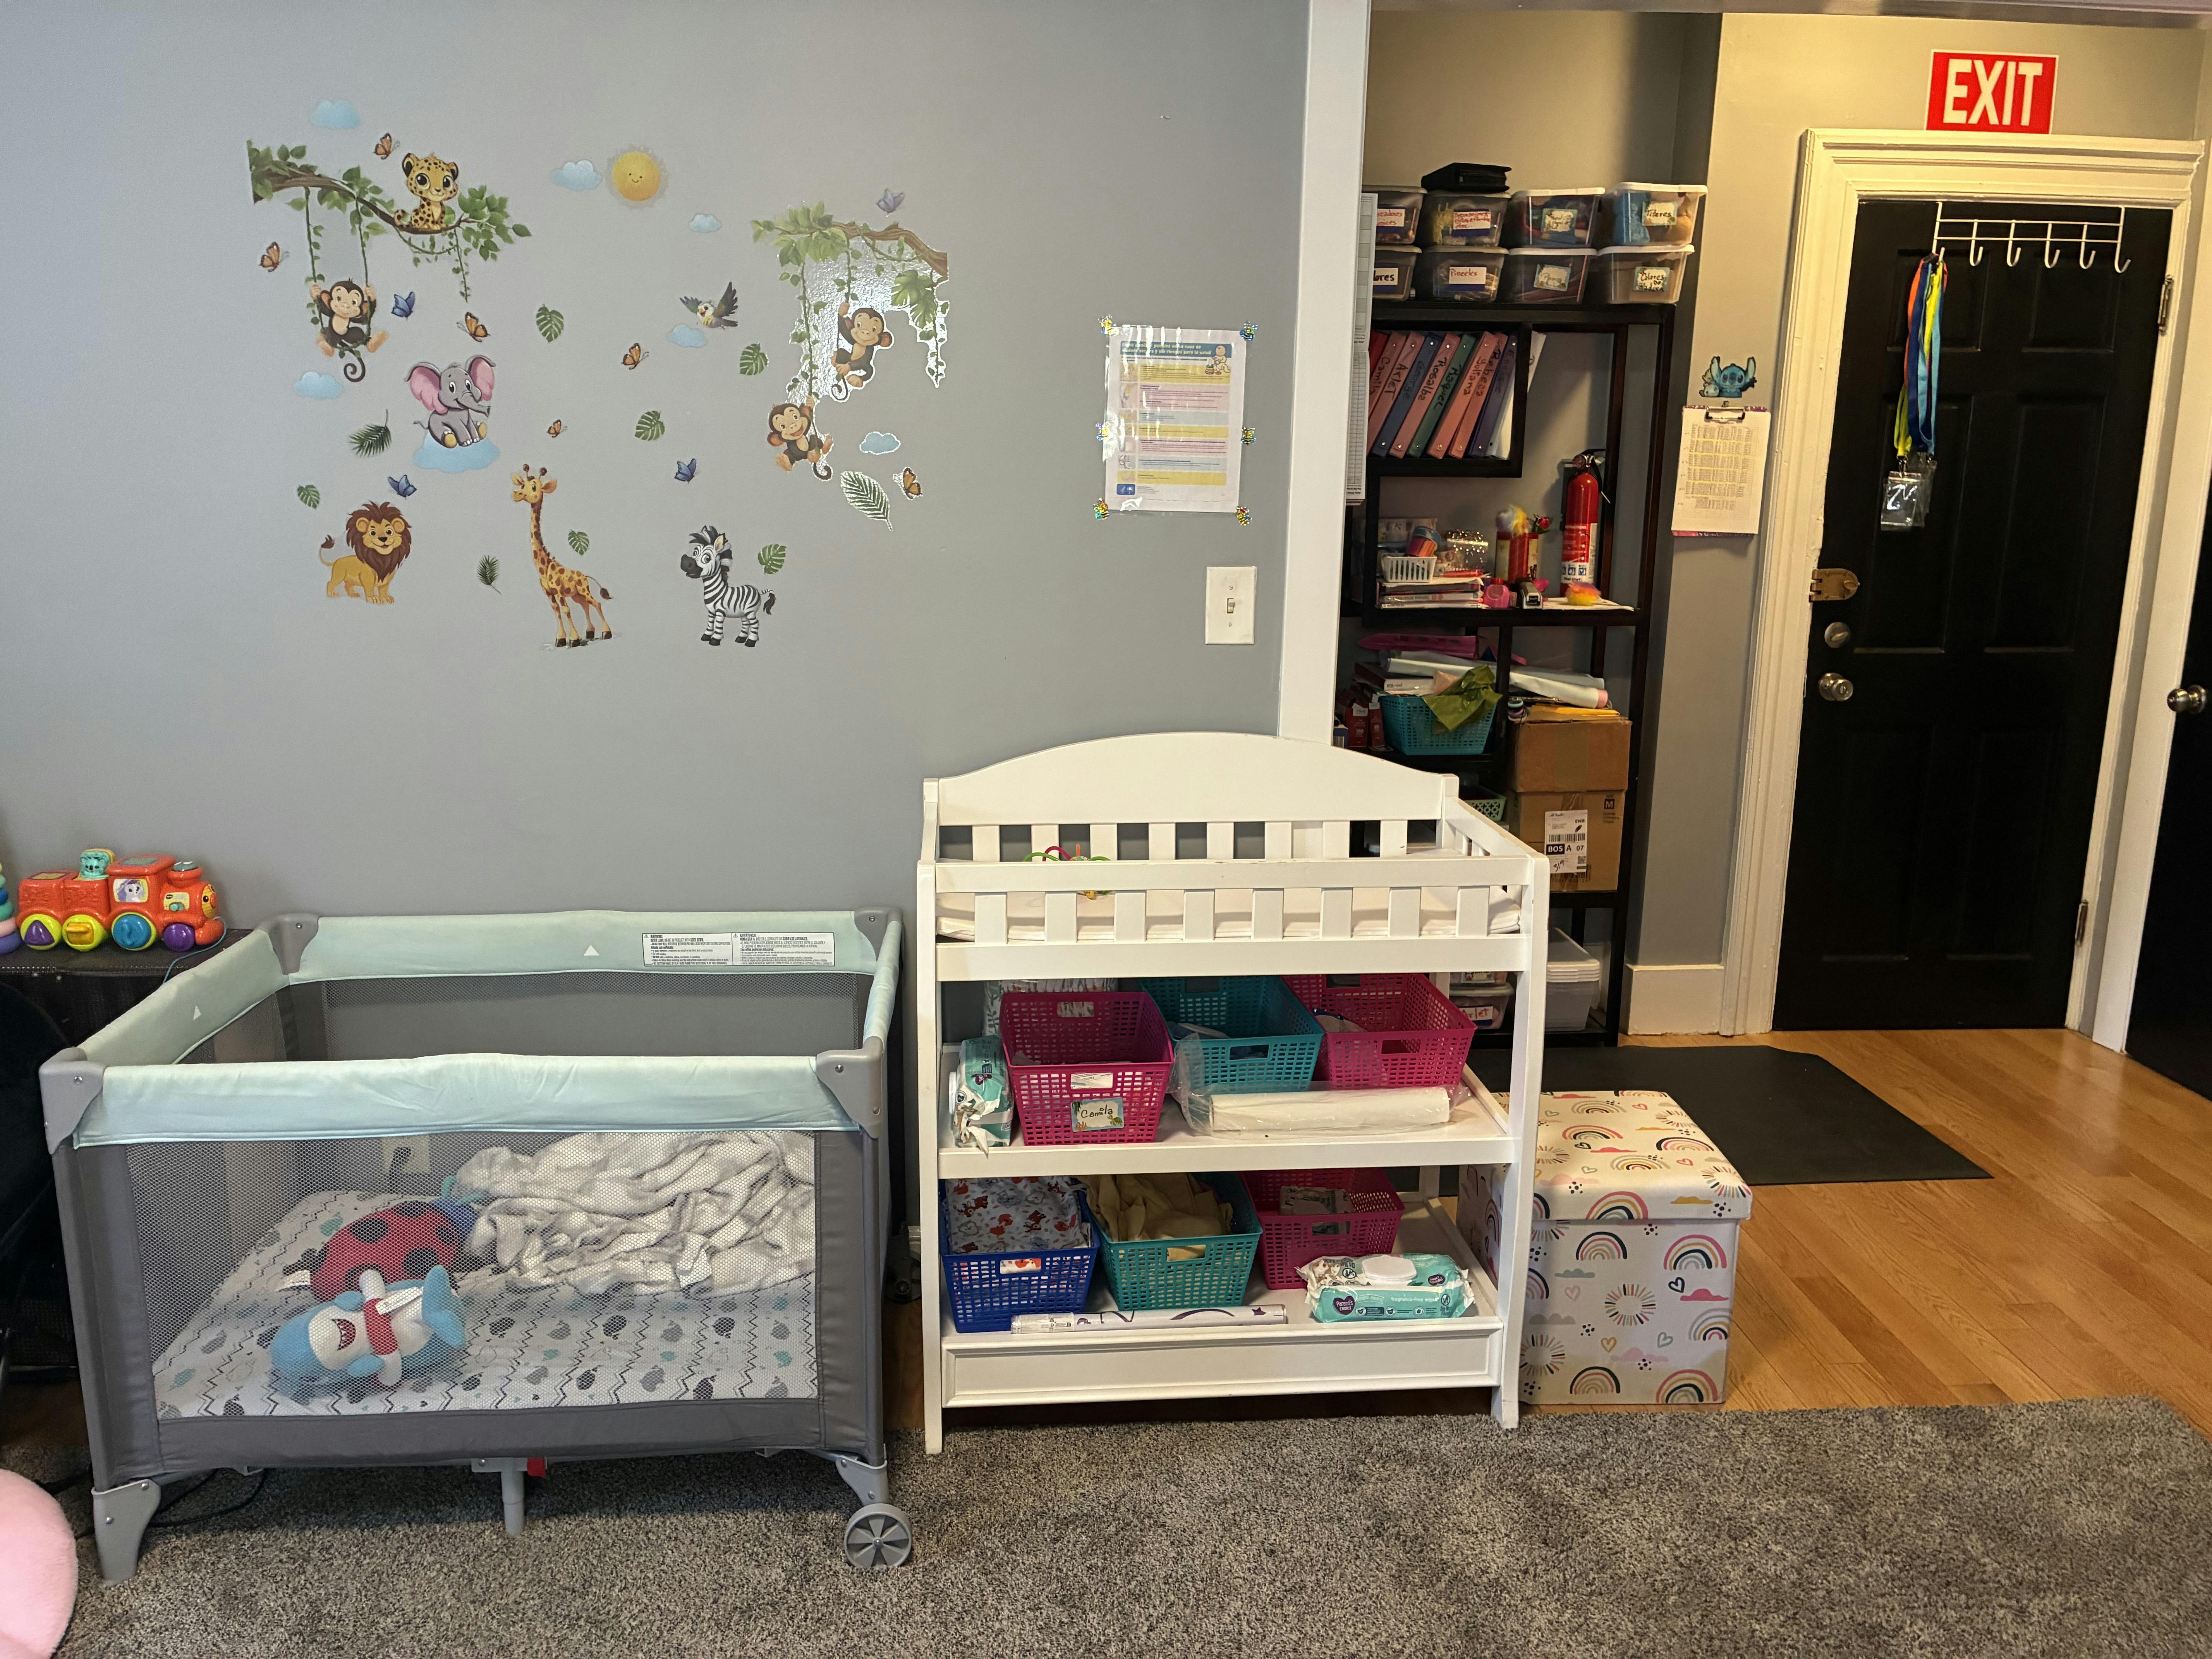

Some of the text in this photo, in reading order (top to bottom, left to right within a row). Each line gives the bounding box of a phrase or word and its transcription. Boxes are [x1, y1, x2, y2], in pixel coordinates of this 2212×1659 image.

[1943, 58, 2043, 126] EXIT
[1418, 357, 1447, 400] Rosalba
[1081, 1104, 1113, 1118] Camila
